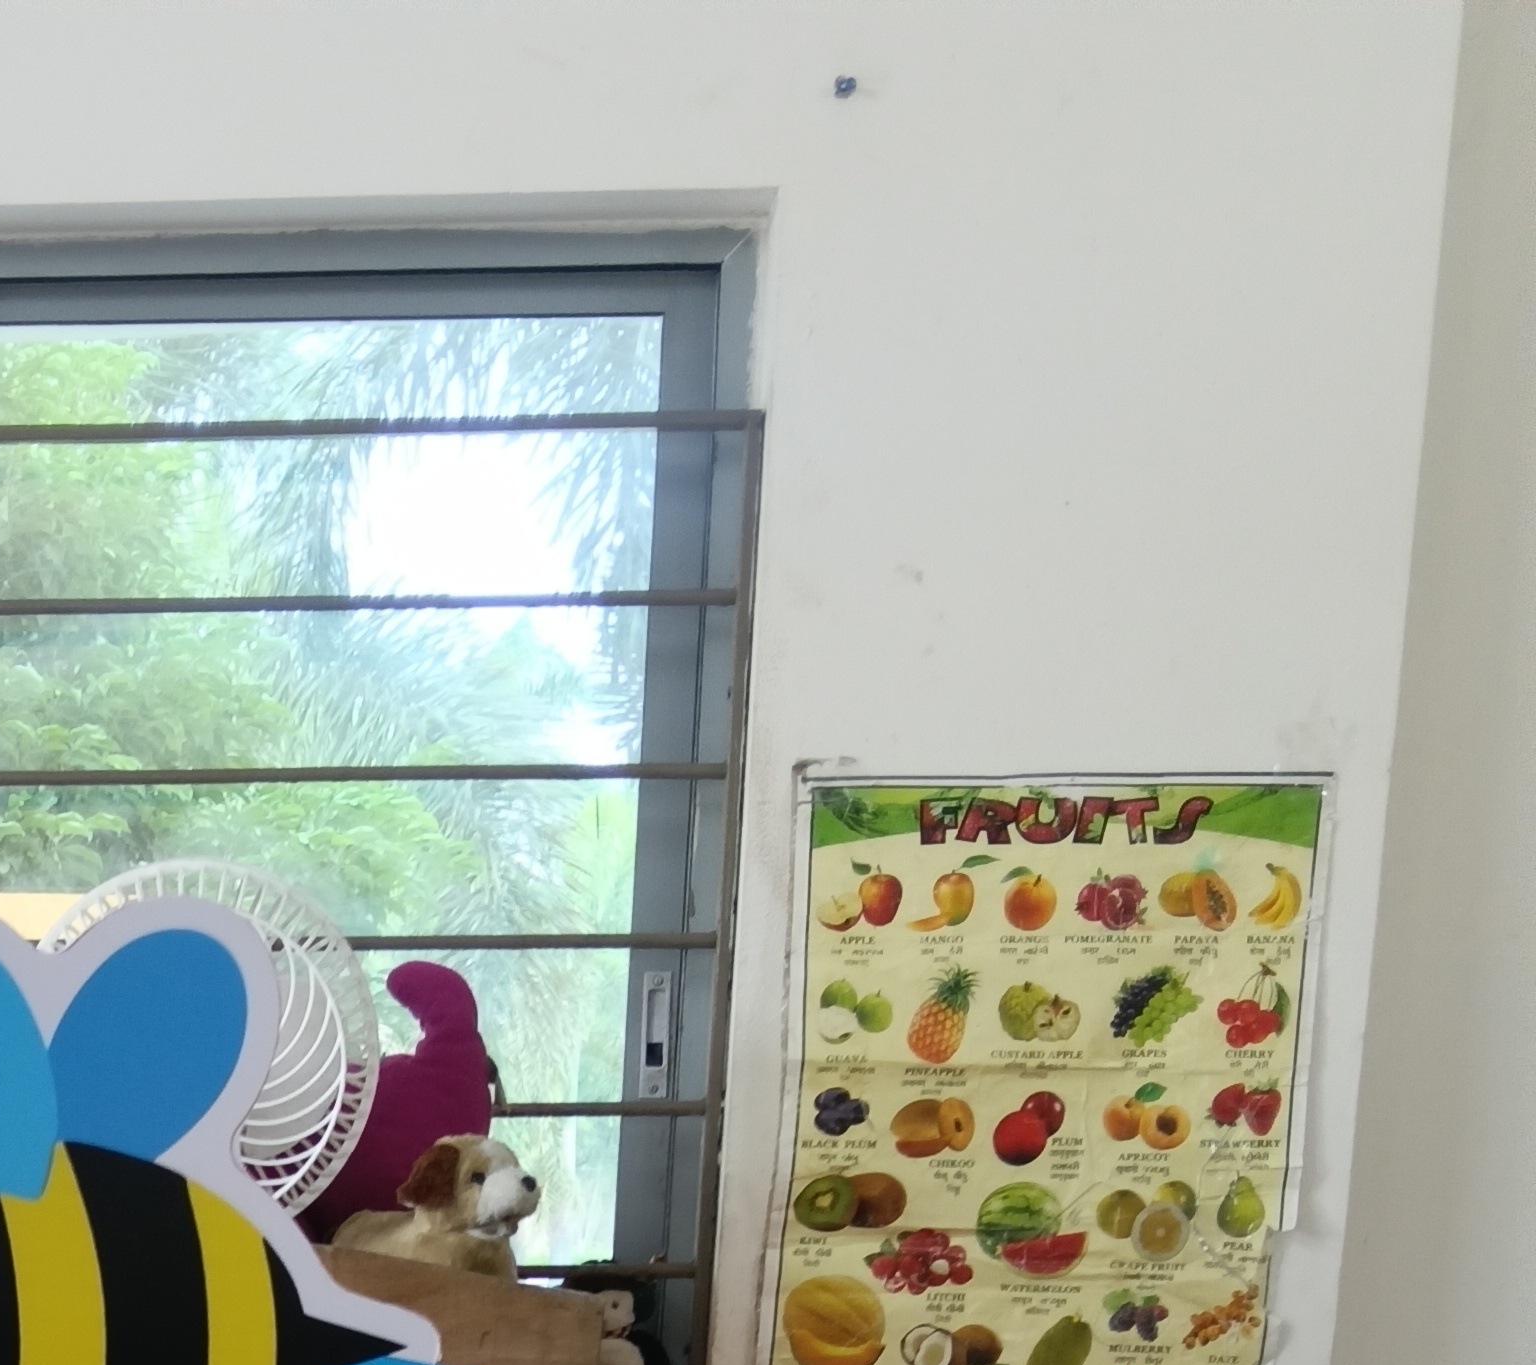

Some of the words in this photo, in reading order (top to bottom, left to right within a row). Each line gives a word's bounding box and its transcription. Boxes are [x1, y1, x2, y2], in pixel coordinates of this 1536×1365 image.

[919, 796, 1215, 846] FRUITS
[839, 935, 877, 945] APPLE
[919, 935, 964, 945] MANGO
[999, 935, 1050, 945] ORANGE
[1064, 935, 1153, 945] POMEGRANATE
[1174, 935, 1219, 945] PAPAYA
[1246, 935, 1296, 945] BANANA
[825, 1054, 868, 1064] GUAVA
[990, 1050, 1046, 1060] CUSTARD
[1048, 1050, 1084, 1060] APPLE
[1121, 1049, 1167, 1059] GRAPES
[1224, 1050, 1275, 1059] CHERRY
[904, 1067, 967, 1077] PINEAPPLE
[801, 1140, 839, 1150] BLACK
[844, 1140, 878, 1150] PLUM
[1051, 1137, 1084, 1147] PLUM
[1117, 1153, 1170, 1162] APRICOT
[928, 1159, 976, 1169] CHIKOO
[798, 1236, 828, 1246] KIWI
[1222, 1241, 1253, 1251] PEAR
[1000, 1283, 1082, 1294] WATERMELON
[1108, 1344, 1173, 1355] MULBERRY
[1208, 1355, 1240, 1365] DATE
